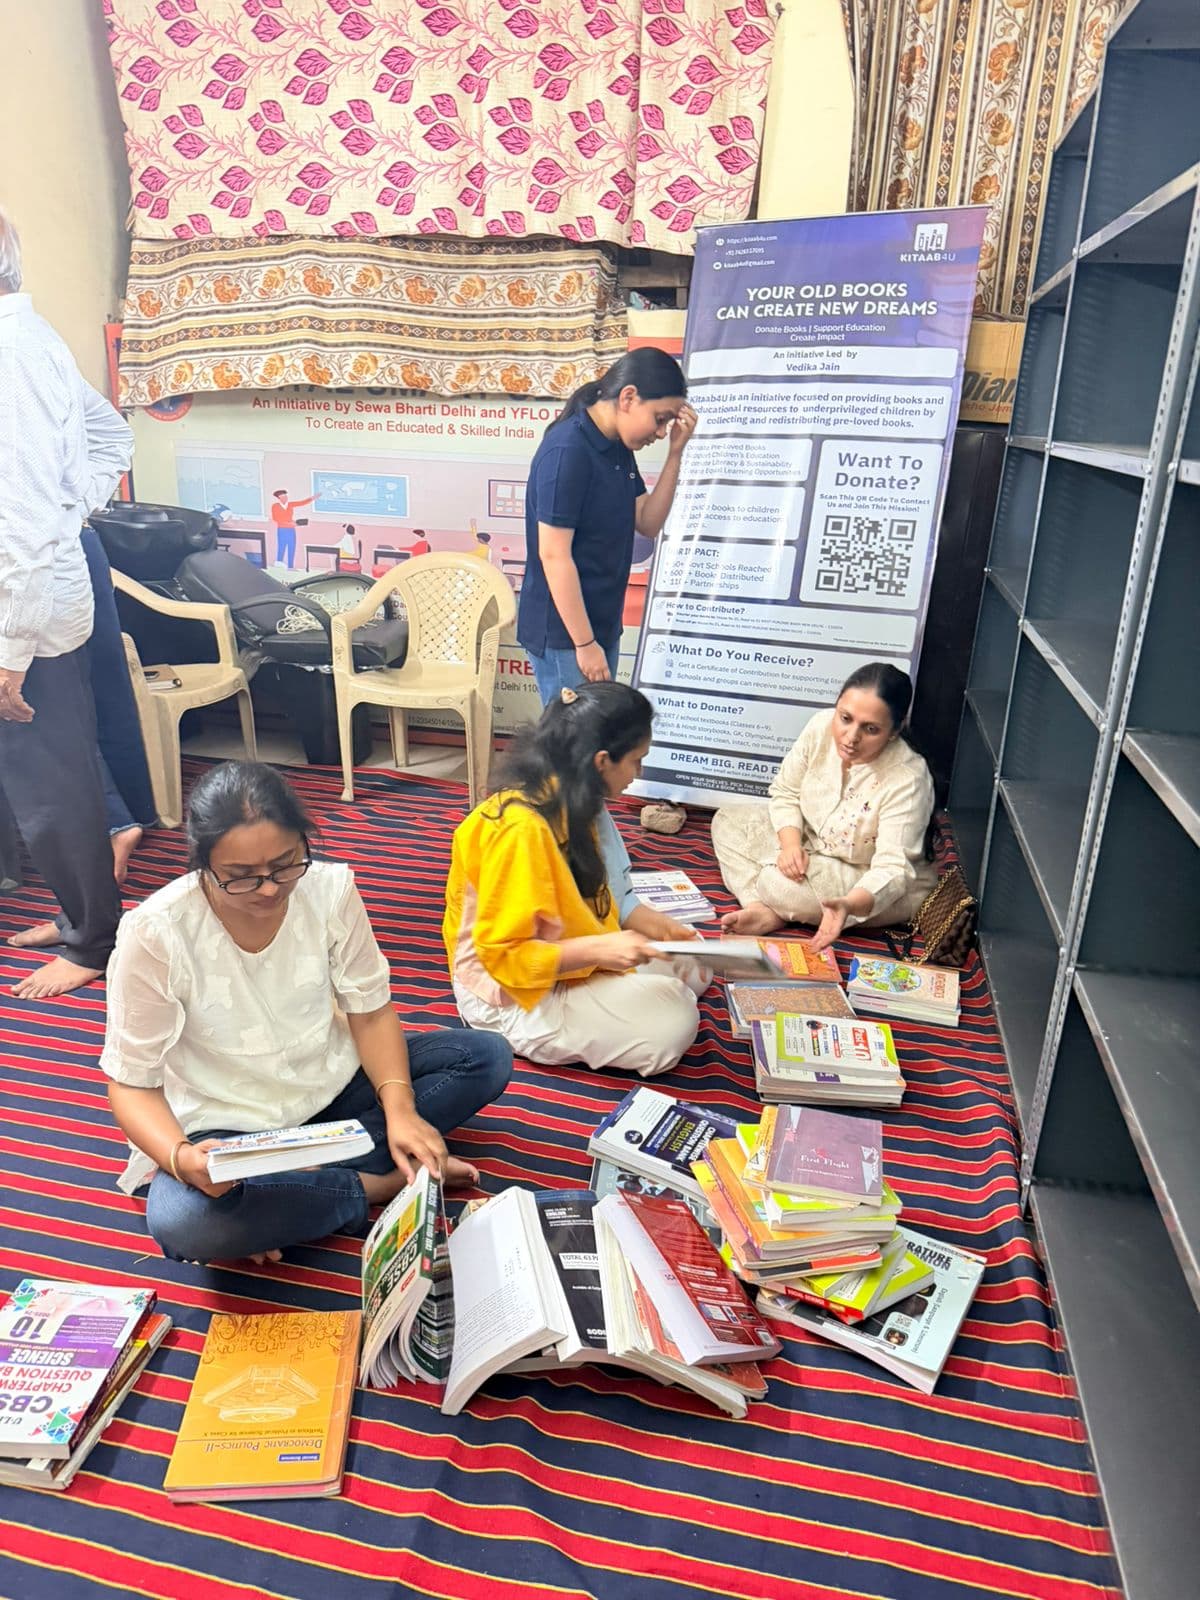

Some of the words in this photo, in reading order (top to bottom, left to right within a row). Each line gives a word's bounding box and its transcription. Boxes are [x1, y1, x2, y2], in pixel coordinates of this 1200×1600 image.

[900, 251, 956, 263] KITAAB4U
[747, 288, 794, 302] YOUR
[800, 285, 837, 299] OLD
[842, 283, 907, 298] BOOKS
[716, 305, 749, 320] CAN
[754, 303, 814, 318] CREATE
[819, 302, 859, 316] NEW
[863, 301, 938, 316] DREAMS
[755, 325, 782, 334] Donate
[783, 324, 807, 334] Books
[813, 323, 844, 334] Support
[846, 323, 886, 333] Education
[790, 333, 816, 342] Create
[817, 333, 845, 343] Impact
[773, 351, 785, 360] An
[826, 350, 842, 359] Led
[846, 350, 858, 360] by
[786, 363, 818, 372] Vedika
[819, 362, 841, 372] Jain
[729, 394, 737, 402] is
[737, 394, 750, 402] an
[751, 393, 792, 402] initiative
[793, 393, 830, 402] focused
[831, 395, 844, 403] on
[845, 394, 891, 406] providing
[892, 395, 922, 405] books
[924, 396, 945, 406] and
[252, 397, 271, 409] An
[335, 400, 351, 415] by
[355, 401, 391, 414] Sewa
[396, 402, 437, 416] Bharti
[441, 404, 476, 418] Delhi
[480, 407, 507, 419] and
[511, 407, 550, 421] YFLO
[743, 405, 787, 414] resources
[788, 405, 799, 413] to
[802, 405, 878, 416] underprivileged
[880, 407, 922, 417] children
[923, 408, 936, 418] by
[305, 416, 321, 429] To
[324, 417, 364, 431] Create
[368, 421, 383, 432] an
[386, 420, 444, 435] Educated
[447, 423, 456, 435] &
[460, 424, 501, 438] Skilled
[505, 426, 536, 439] India
[706, 415, 748, 425] collecting
[750, 416, 767, 425] and
[768, 416, 831, 427] redistributing
[833, 417, 880, 428] pre-loved
[882, 418, 915, 428] books.
[838, 452, 893, 469] Want
[899, 455, 923, 471] To
[835, 472, 921, 490] Donate?
[888, 505, 920, 513] Mission!
[686, 603, 694, 611] to
[669, 643, 702, 657] What
[706, 647, 723, 658] Do
[726, 649, 751, 662] You
[754, 651, 815, 668] Receive?
[678, 661, 691, 669] Get
[696, 663, 730, 674] Certificate
[739, 667, 781, 678] Contribution
[501, 681, 522, 692] Delhi
[677, 672, 701, 681] Schools
[703, 675, 716, 683] and
[716, 677, 739, 686] groups
[740, 679, 753, 687] can
[658, 696, 685, 709] What
[687, 700, 698, 710] to
[700, 702, 745, 715] Donate?
[670, 752, 709, 766] DREAM
[711, 758, 735, 769] BIG.
[738, 761, 769, 774] READ
[669, 1120, 695, 1153] ENGLISH
[686, 1118, 709, 1147] QUESTION
[675, 1144, 691, 1163] BANK
[906, 1241, 953, 1263] RATURE
[386, 1243, 418, 1292] CBSE
[9, 1316, 47, 1339] 10
[8, 1349, 73, 1365] SCIENCE
[17, 1368, 92, 1380] QUESTION
